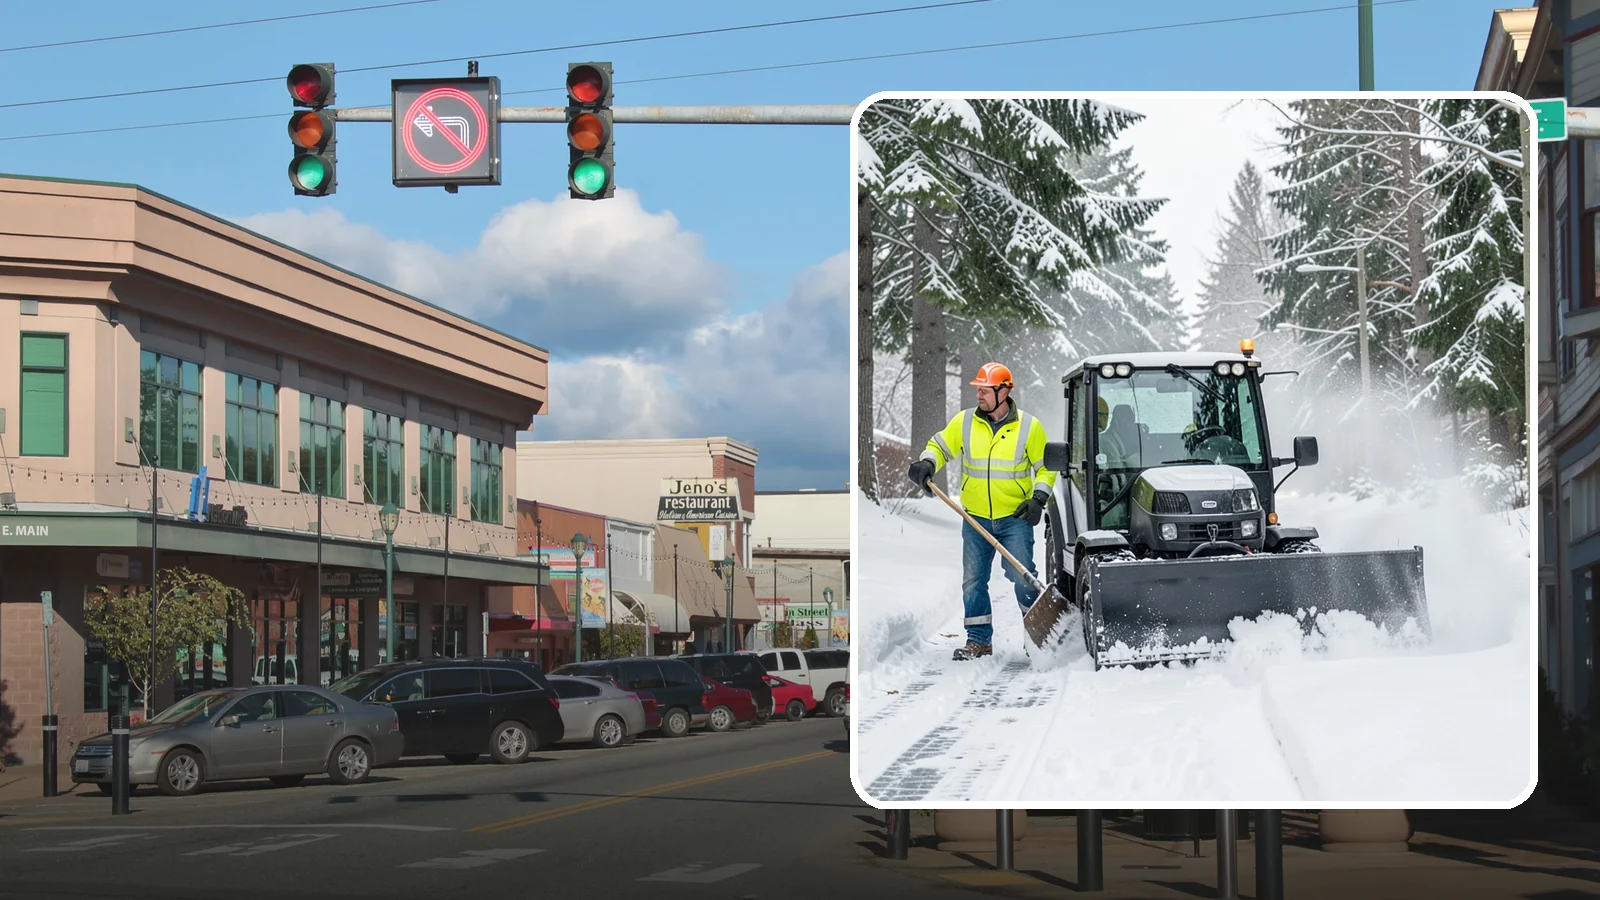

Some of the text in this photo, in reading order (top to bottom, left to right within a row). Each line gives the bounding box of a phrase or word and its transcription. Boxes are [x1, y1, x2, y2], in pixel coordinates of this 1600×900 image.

[670, 480, 727, 493] Jeno's
[665, 496, 731, 508] restaurant
[659, 509, 681, 519] Italian
[686, 509, 715, 519] American
[714, 509, 738, 519] Cuisine
[2, 525, 49, 536] E. MAIN
[786, 607, 828, 617] in Street
[790, 619, 823, 627] lass
